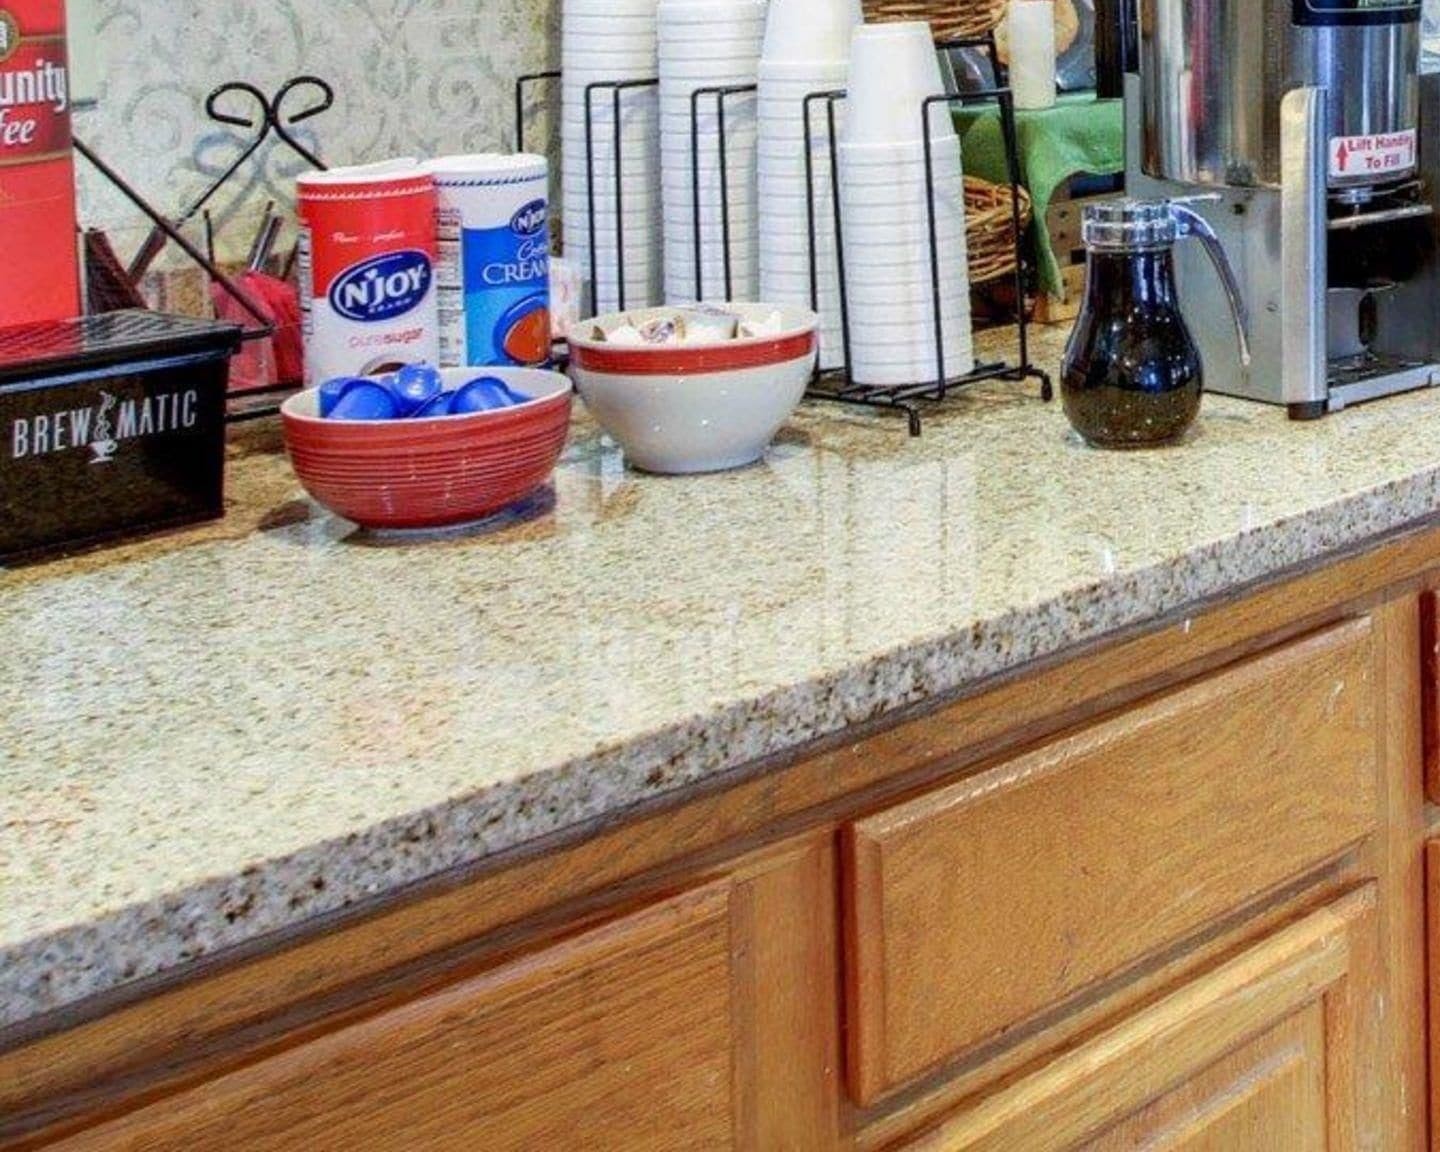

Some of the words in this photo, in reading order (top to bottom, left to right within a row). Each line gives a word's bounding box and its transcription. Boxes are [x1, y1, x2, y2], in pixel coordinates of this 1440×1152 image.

[1347, 139, 1373, 151] Lift
[1365, 156, 1382, 169] To
[12, 407, 93, 459] BREW
[116, 389, 198, 440] MATIC
